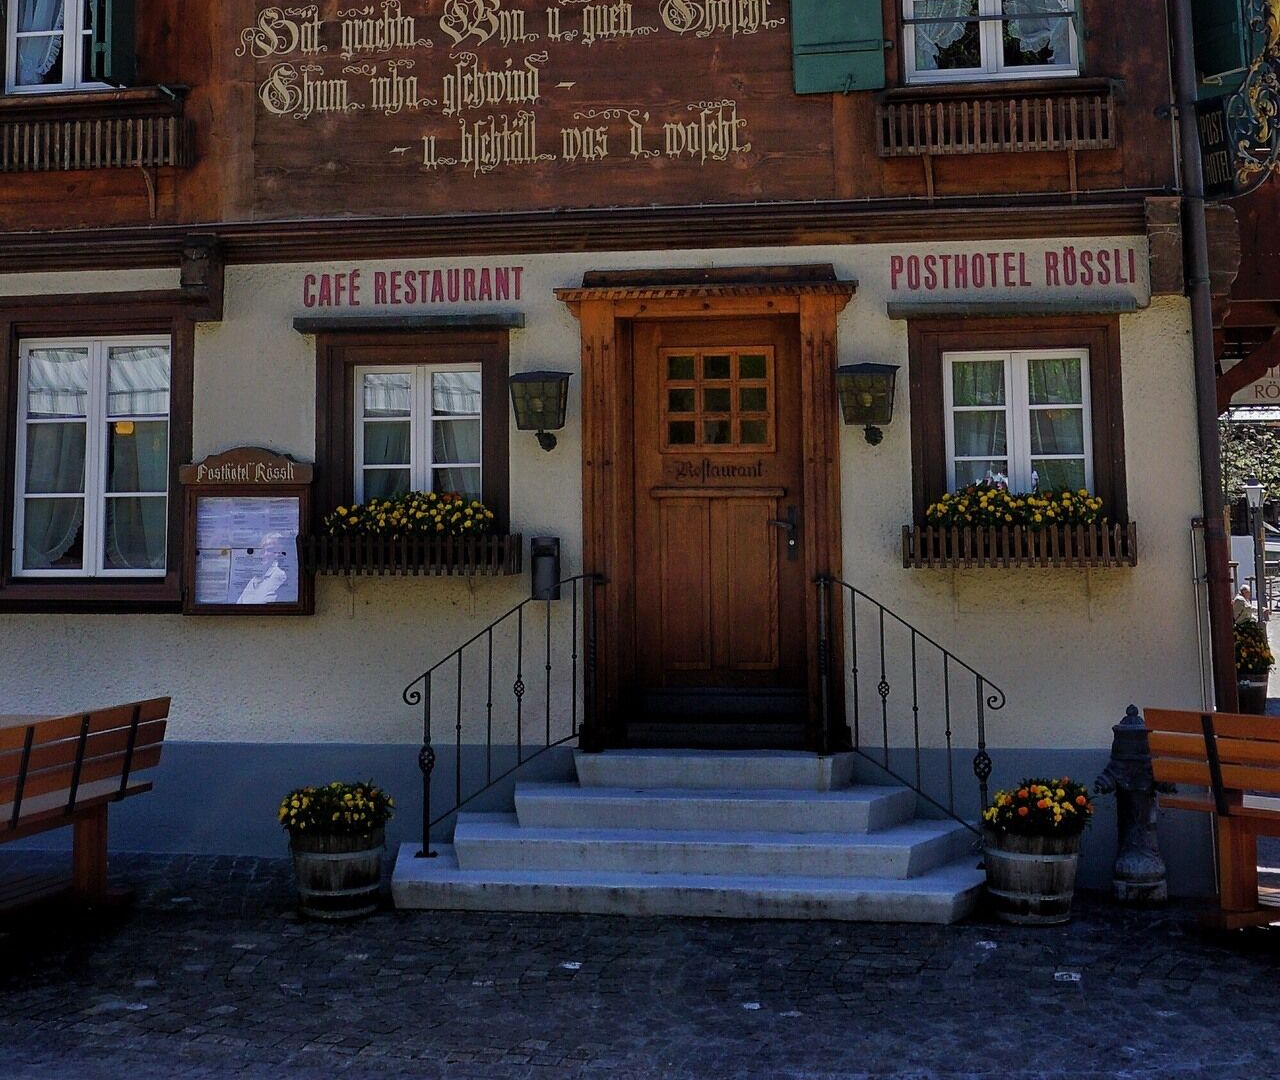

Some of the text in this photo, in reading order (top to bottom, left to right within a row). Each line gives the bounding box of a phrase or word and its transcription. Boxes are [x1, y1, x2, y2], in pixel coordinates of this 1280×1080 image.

[303, 266, 524, 307] CAFÉ RESTAURANT
[890, 246, 1136, 290] POSTHOTEL RÖSSLI
